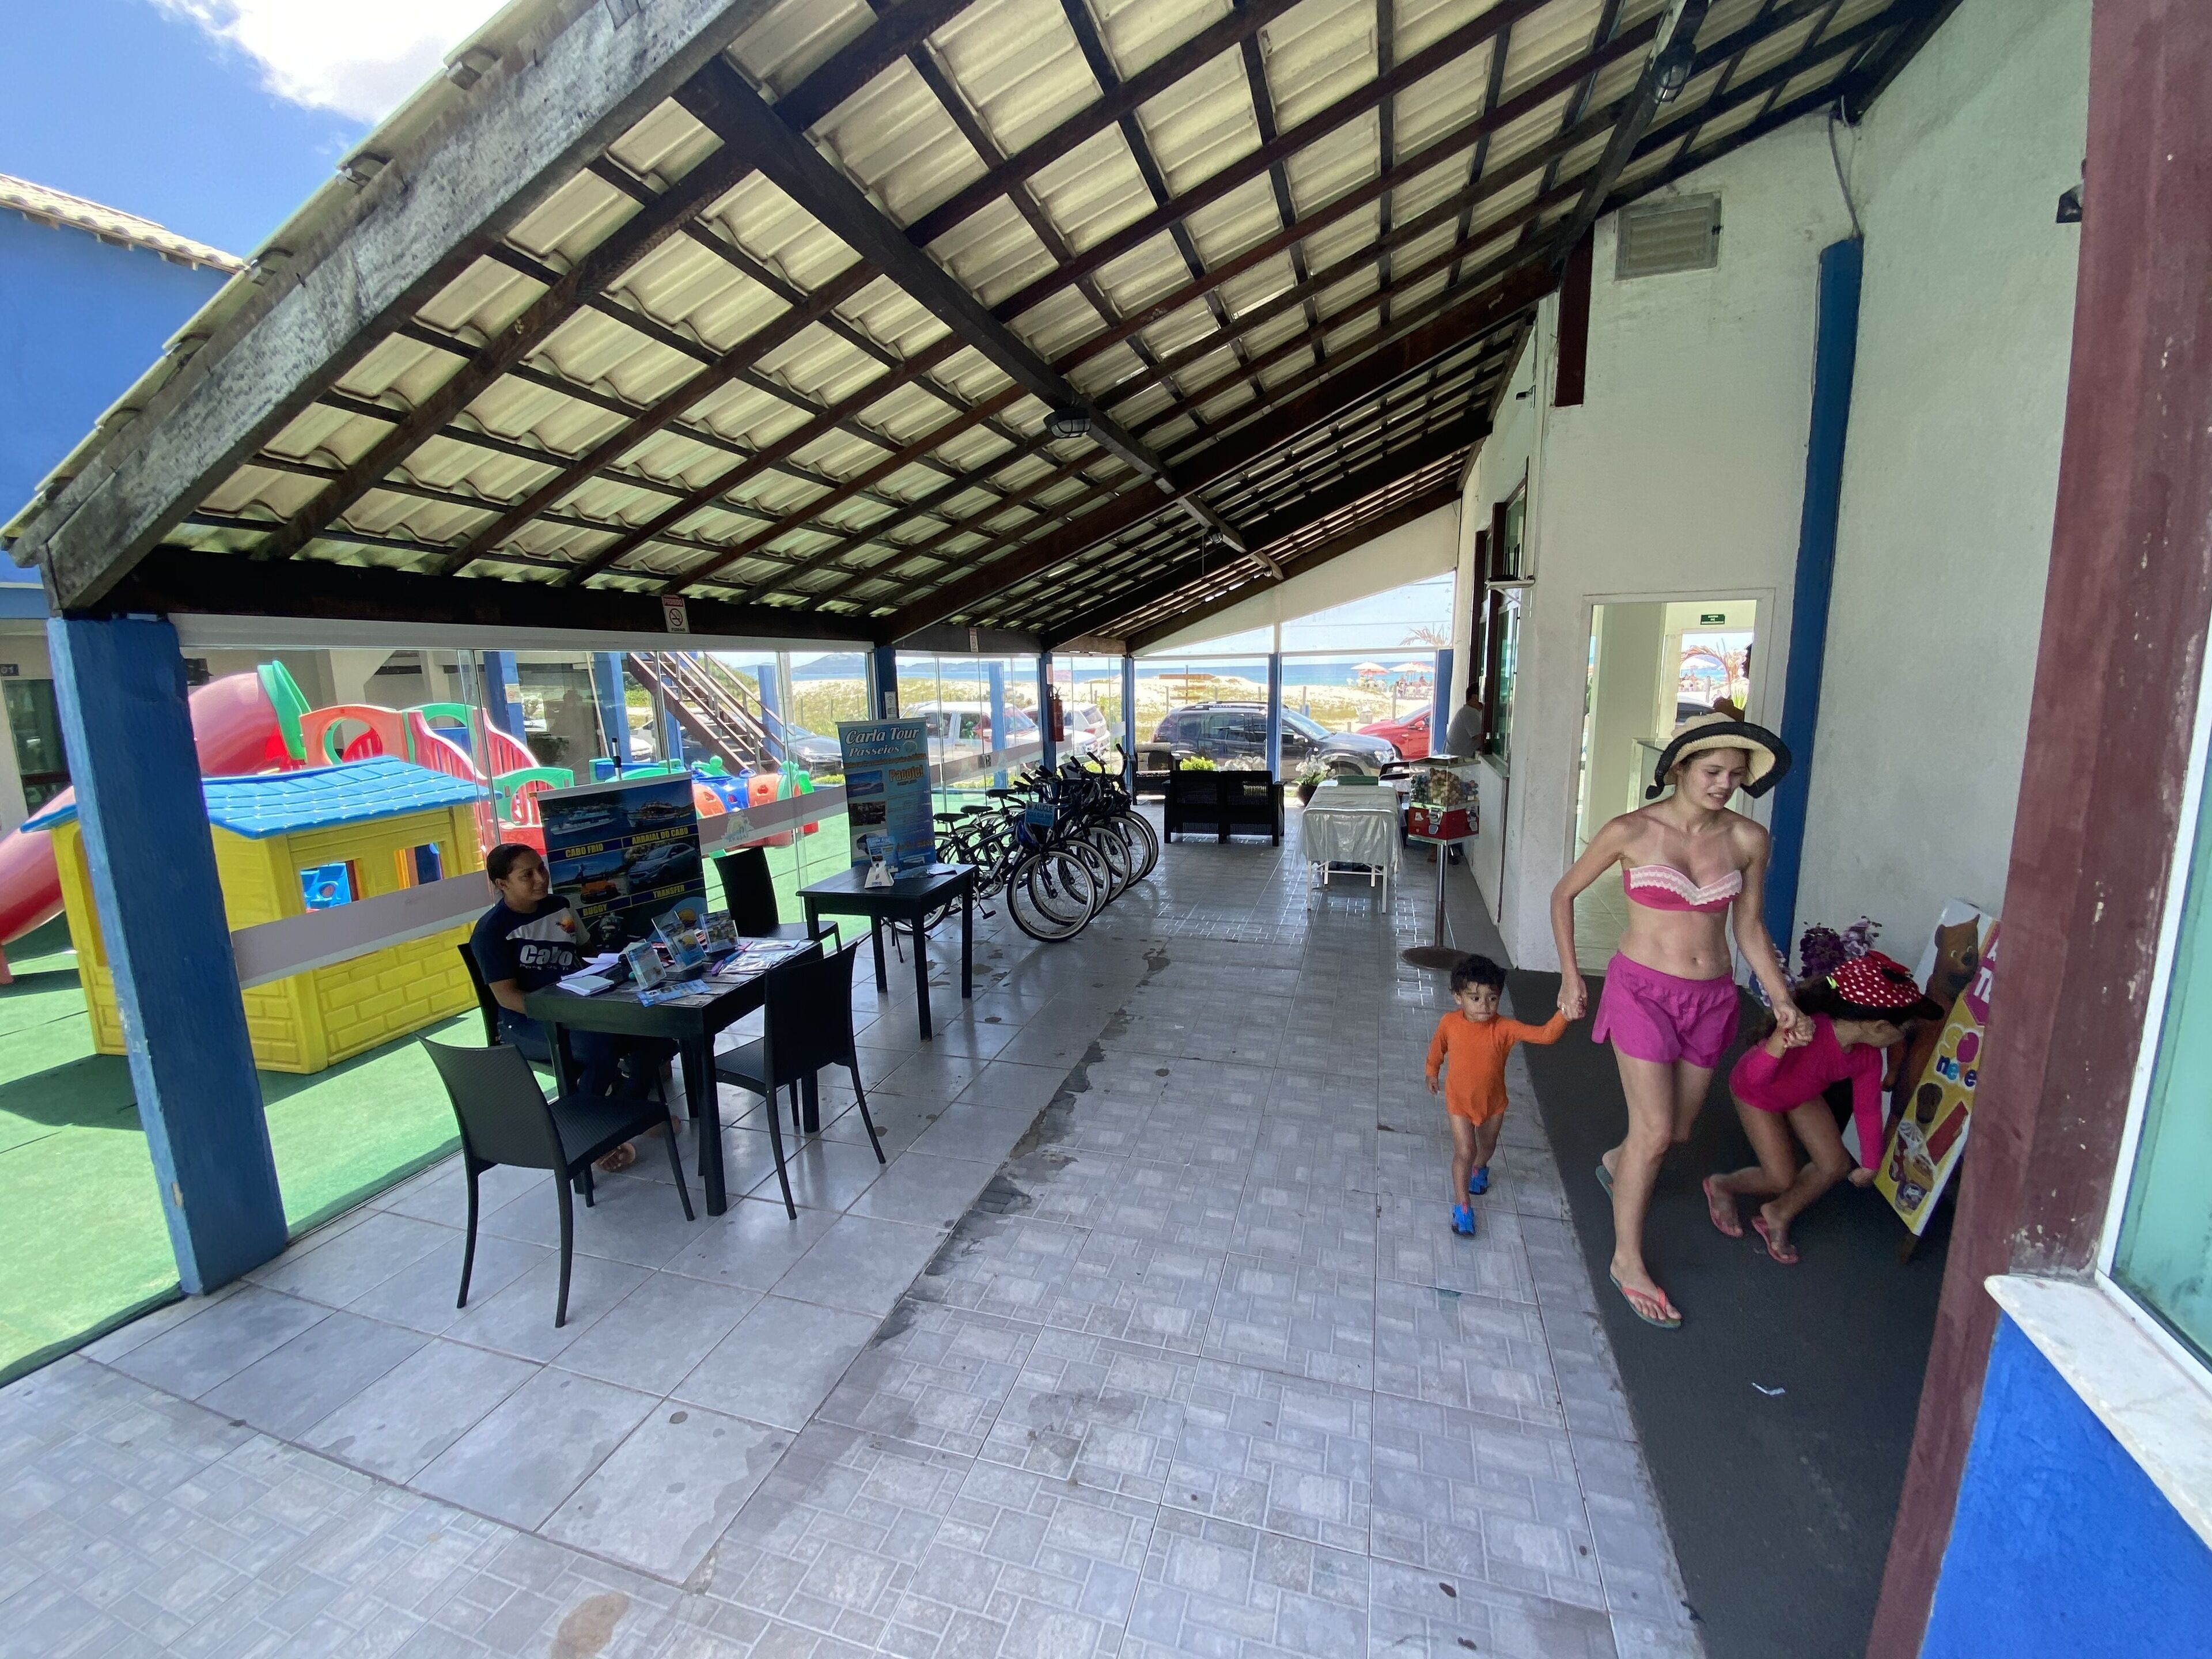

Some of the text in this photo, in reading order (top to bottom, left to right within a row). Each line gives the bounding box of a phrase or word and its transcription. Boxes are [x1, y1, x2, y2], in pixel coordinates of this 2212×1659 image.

[845, 727, 920, 745] Carla Tour
[849, 745, 900, 757] Passeios
[632, 827, 688, 844] ARRAIAL DO CABO
[565, 843, 604, 858] CABO FRIO
[653, 884, 685, 899] TRANSFER
[582, 903, 607, 916] BUGGY
